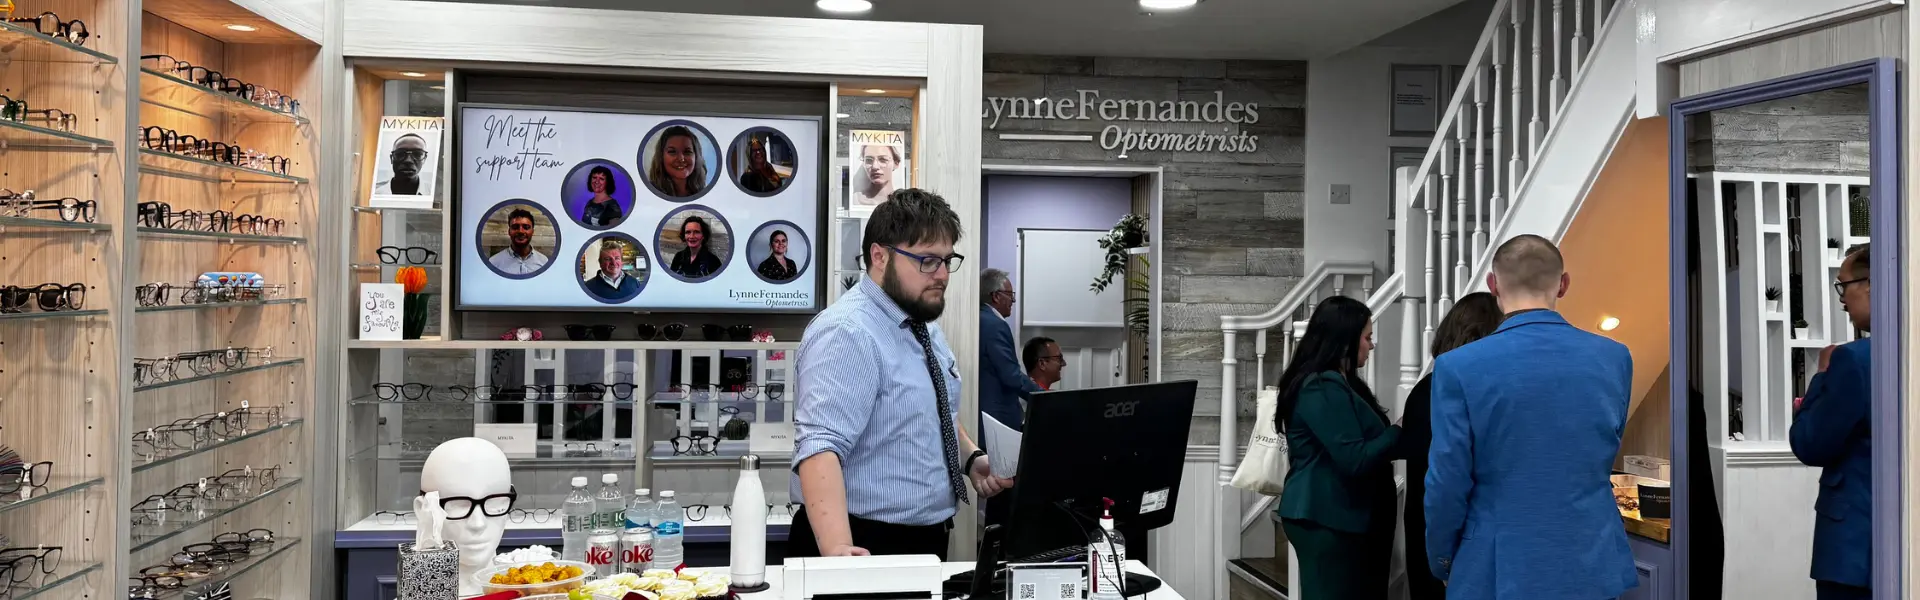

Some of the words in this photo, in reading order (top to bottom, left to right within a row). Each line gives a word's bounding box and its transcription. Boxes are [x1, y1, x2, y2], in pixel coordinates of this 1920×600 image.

[981, 89, 1259, 129] ynneFernandes
[383, 119, 439, 130] MYKITA
[484, 115, 531, 150] Meet
[532, 116, 557, 150] the
[852, 132, 902, 144] MYKITA
[1100, 124, 1259, 158] Optometrists
[476, 148, 529, 181] support
[530, 148, 564, 180] team
[729, 289, 809, 301] LynneFernandes
[765, 299, 809, 308] Optometrists
[1103, 400, 1140, 418] acer
[621, 545, 654, 564] oke
